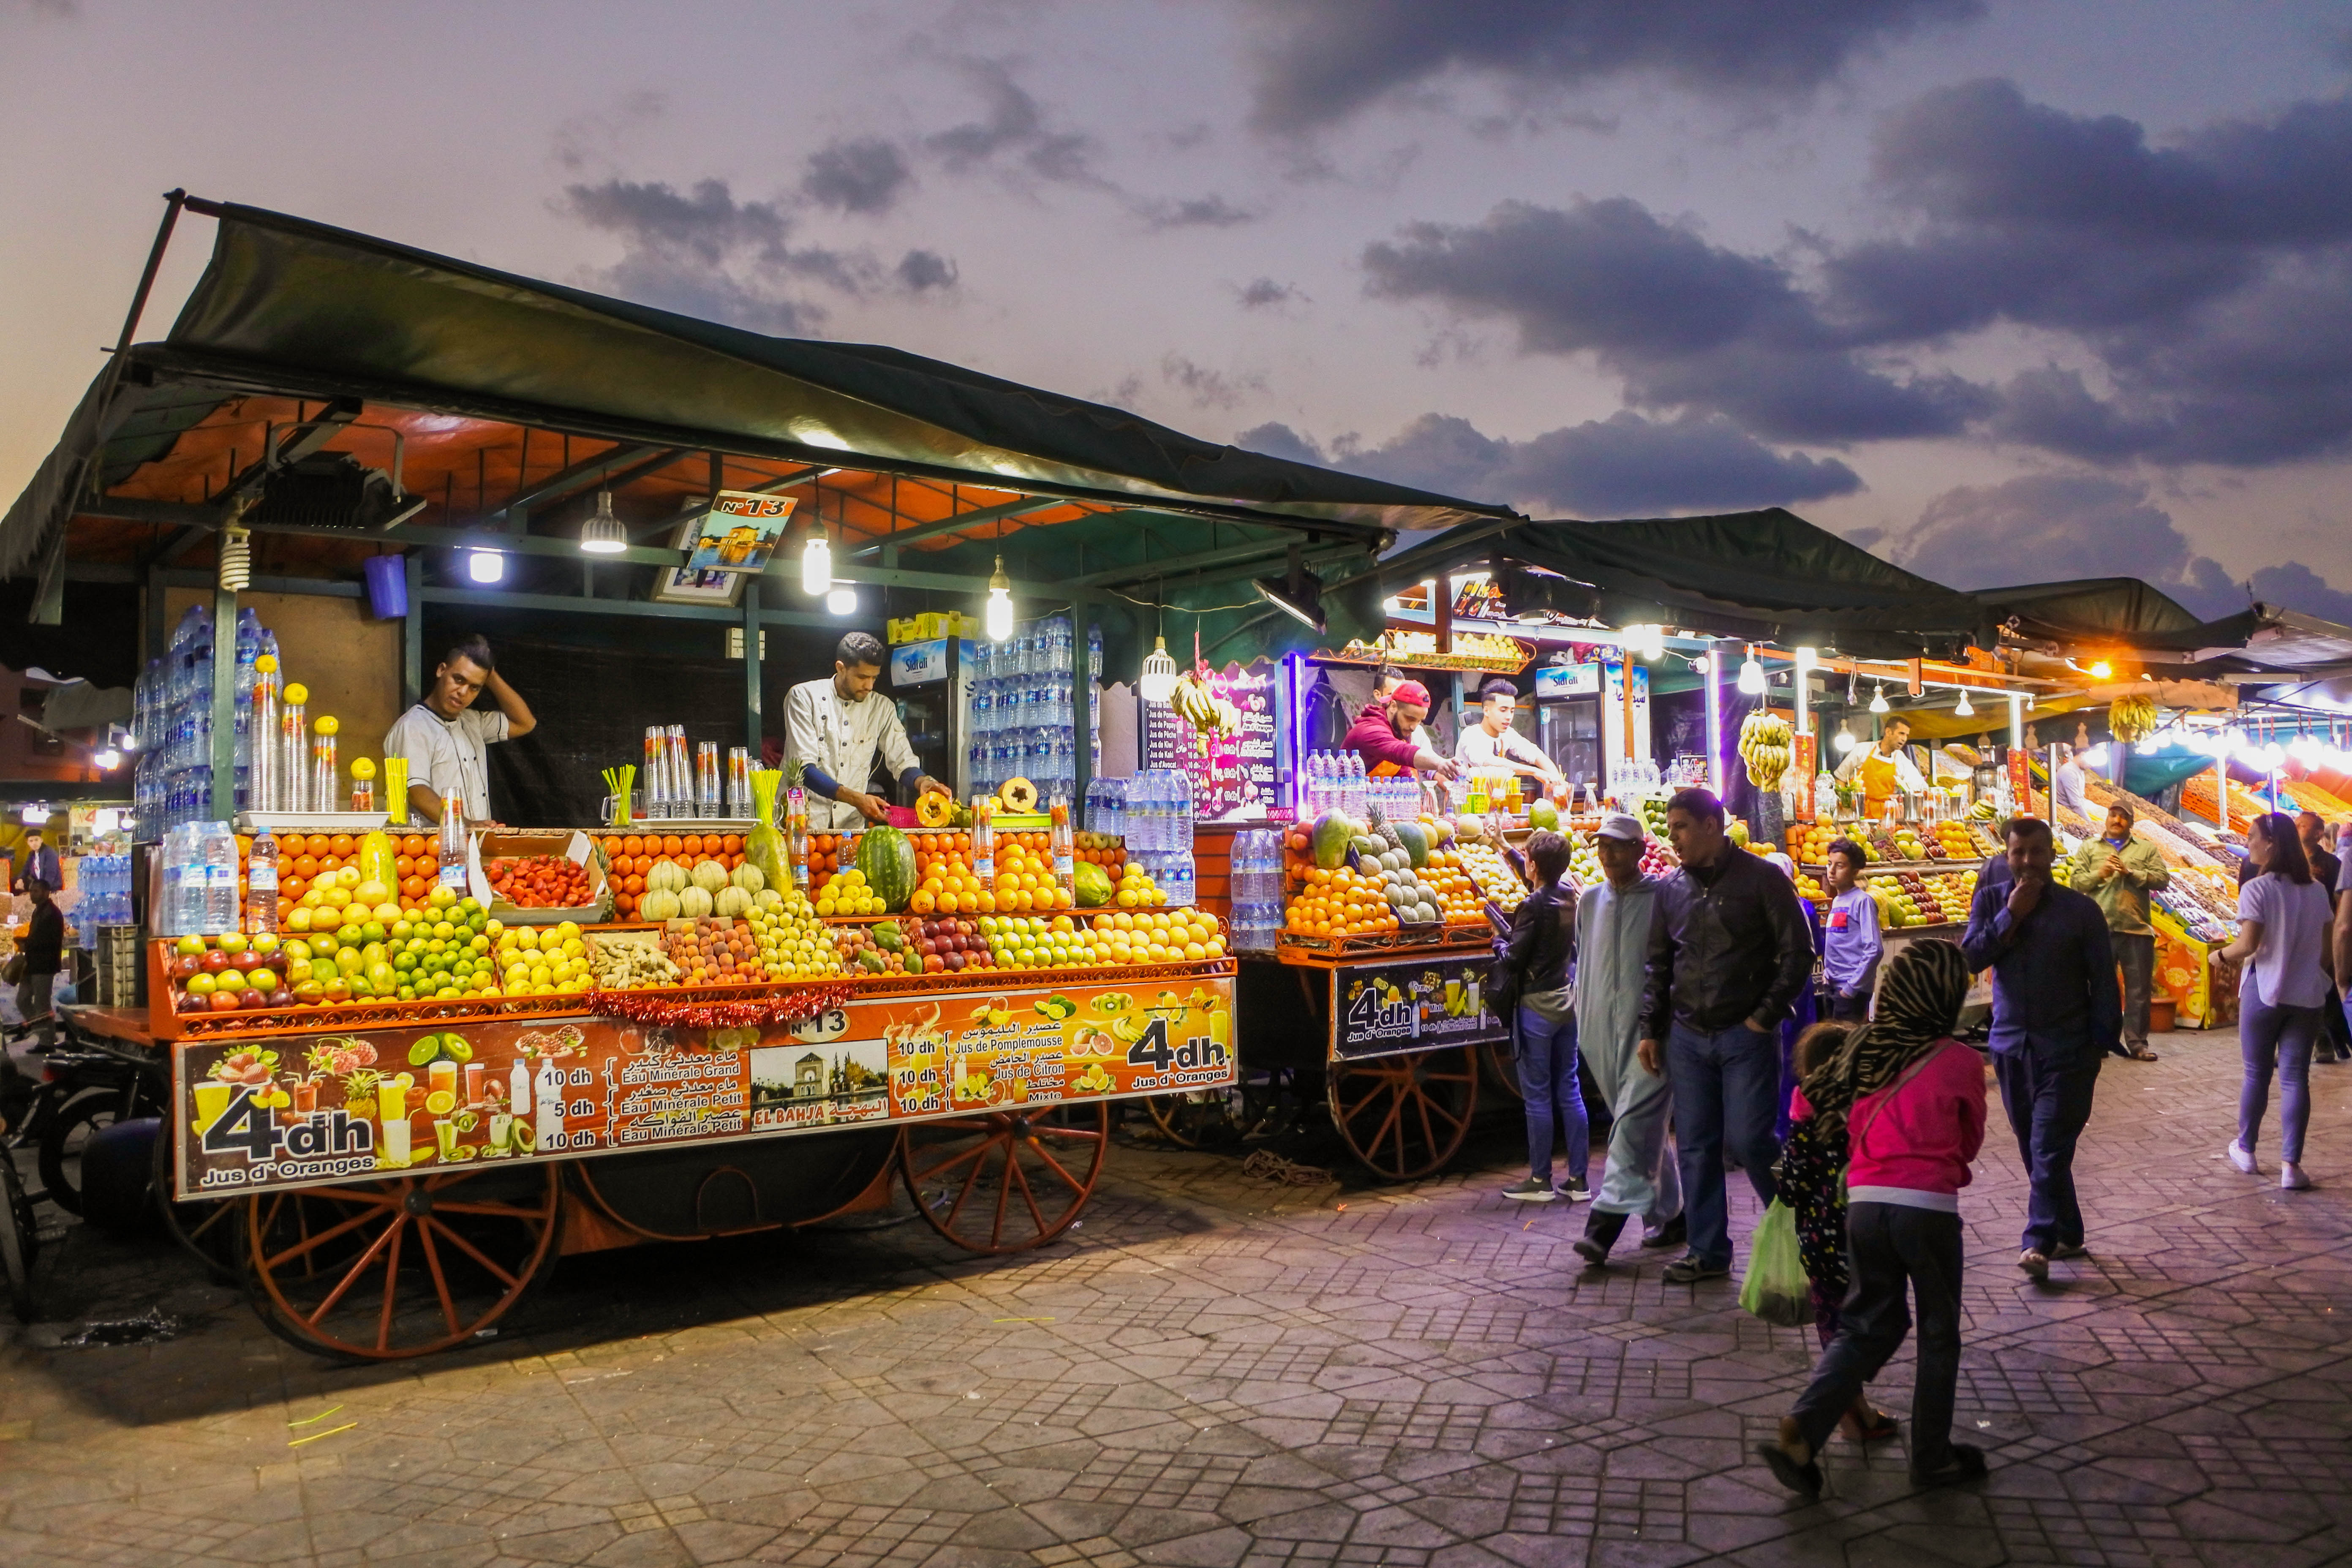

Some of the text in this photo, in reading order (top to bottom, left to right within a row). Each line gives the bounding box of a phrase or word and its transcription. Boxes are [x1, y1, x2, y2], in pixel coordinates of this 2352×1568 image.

[906, 659, 918, 672] Sidi
[1553, 677, 1578, 687] Sidi ali
[1158, 730, 1163, 738] de
[1158, 740, 1163, 749] de
[1164, 740, 1173, 749] Kiwi
[1224, 744, 1235, 754] 10 dh
[1164, 750, 1174, 758] Kaki
[1159, 760, 1176, 768] d'Avocat
[1194, 771, 1199, 779] dh
[1224, 768, 1236, 778] 10 dh
[1225, 791, 1236, 800] 10 dh
[1430, 1003, 1444, 1012] Mixte
[1026, 1021, 1062, 1034] عصير
[1348, 1033, 1364, 1042] Jus
[898, 1040, 935, 1056] 10 dh
[955, 1037, 1062, 1054] Jus de Pomplemousse
[628, 1051, 737, 1071] ماء معدني كبير
[990, 1051, 1063, 1068] عصير الحامض
[544, 1069, 592, 1086] 10 dh
[623, 1063, 740, 1083] Eau Minérale Grand
[899, 1069, 936, 1084] 10 dh
[994, 1063, 1064, 1080] Jus de Citron
[1025, 1077, 1064, 1089] مختلط
[1132, 1076, 1156, 1089] Jus
[628, 1079, 738, 1102] ماء معدني صغير
[1028, 1092, 1062, 1102] Mixte
[554, 1102, 565, 1117] 5
[571, 1101, 594, 1116] dh
[622, 1093, 743, 1114] Eau Minérale Petit
[828, 1098, 888, 1120] البهجة
[900, 1097, 939, 1113] 10 dh
[701, 1109, 742, 1124] عصير
[754, 1104, 825, 1126] EL BAHJA
[622, 1120, 743, 1142] Eau Minérale Petit
[546, 1130, 595, 1149] 10 dh
[203, 1169, 245, 1185] Jus
